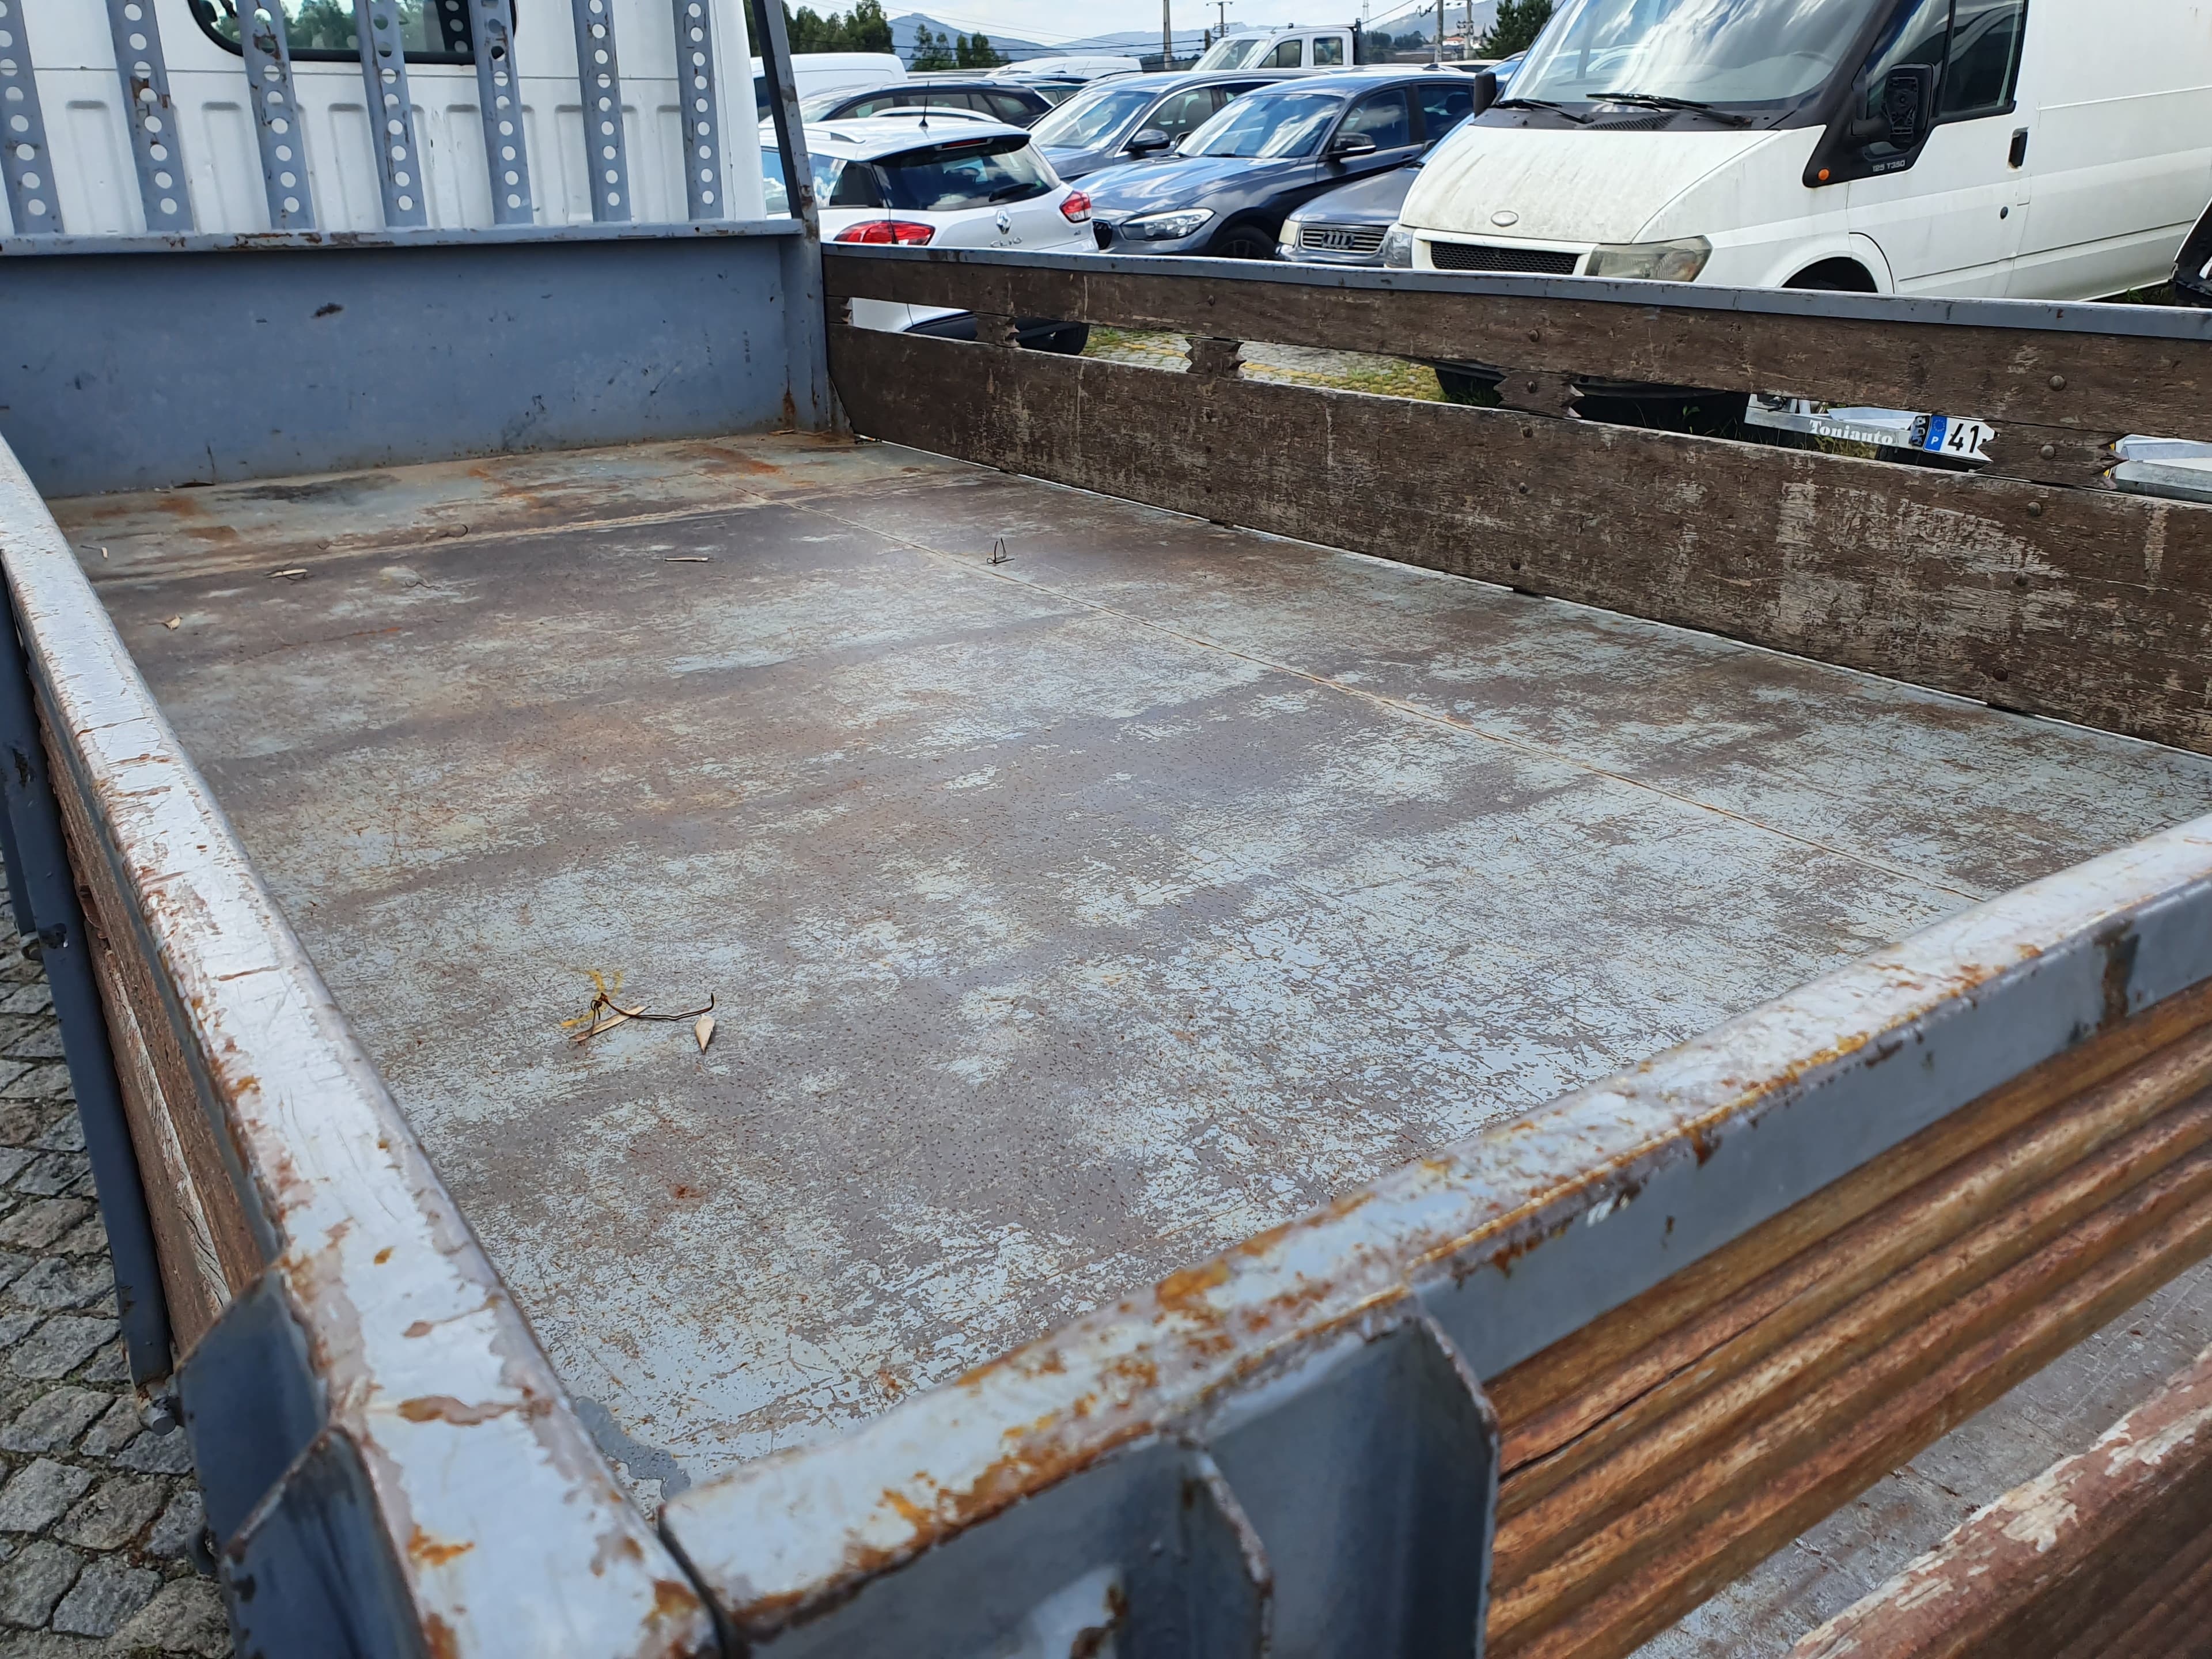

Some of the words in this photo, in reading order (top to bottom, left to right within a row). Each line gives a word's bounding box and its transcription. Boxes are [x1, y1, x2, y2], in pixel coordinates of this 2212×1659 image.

[1872, 164, 1885, 172] 125
[1887, 160, 1906, 169] T350
[990, 237, 1023, 248] CLIO
[1809, 419, 1893, 445] Toniauto
[1930, 437, 1940, 445] P
